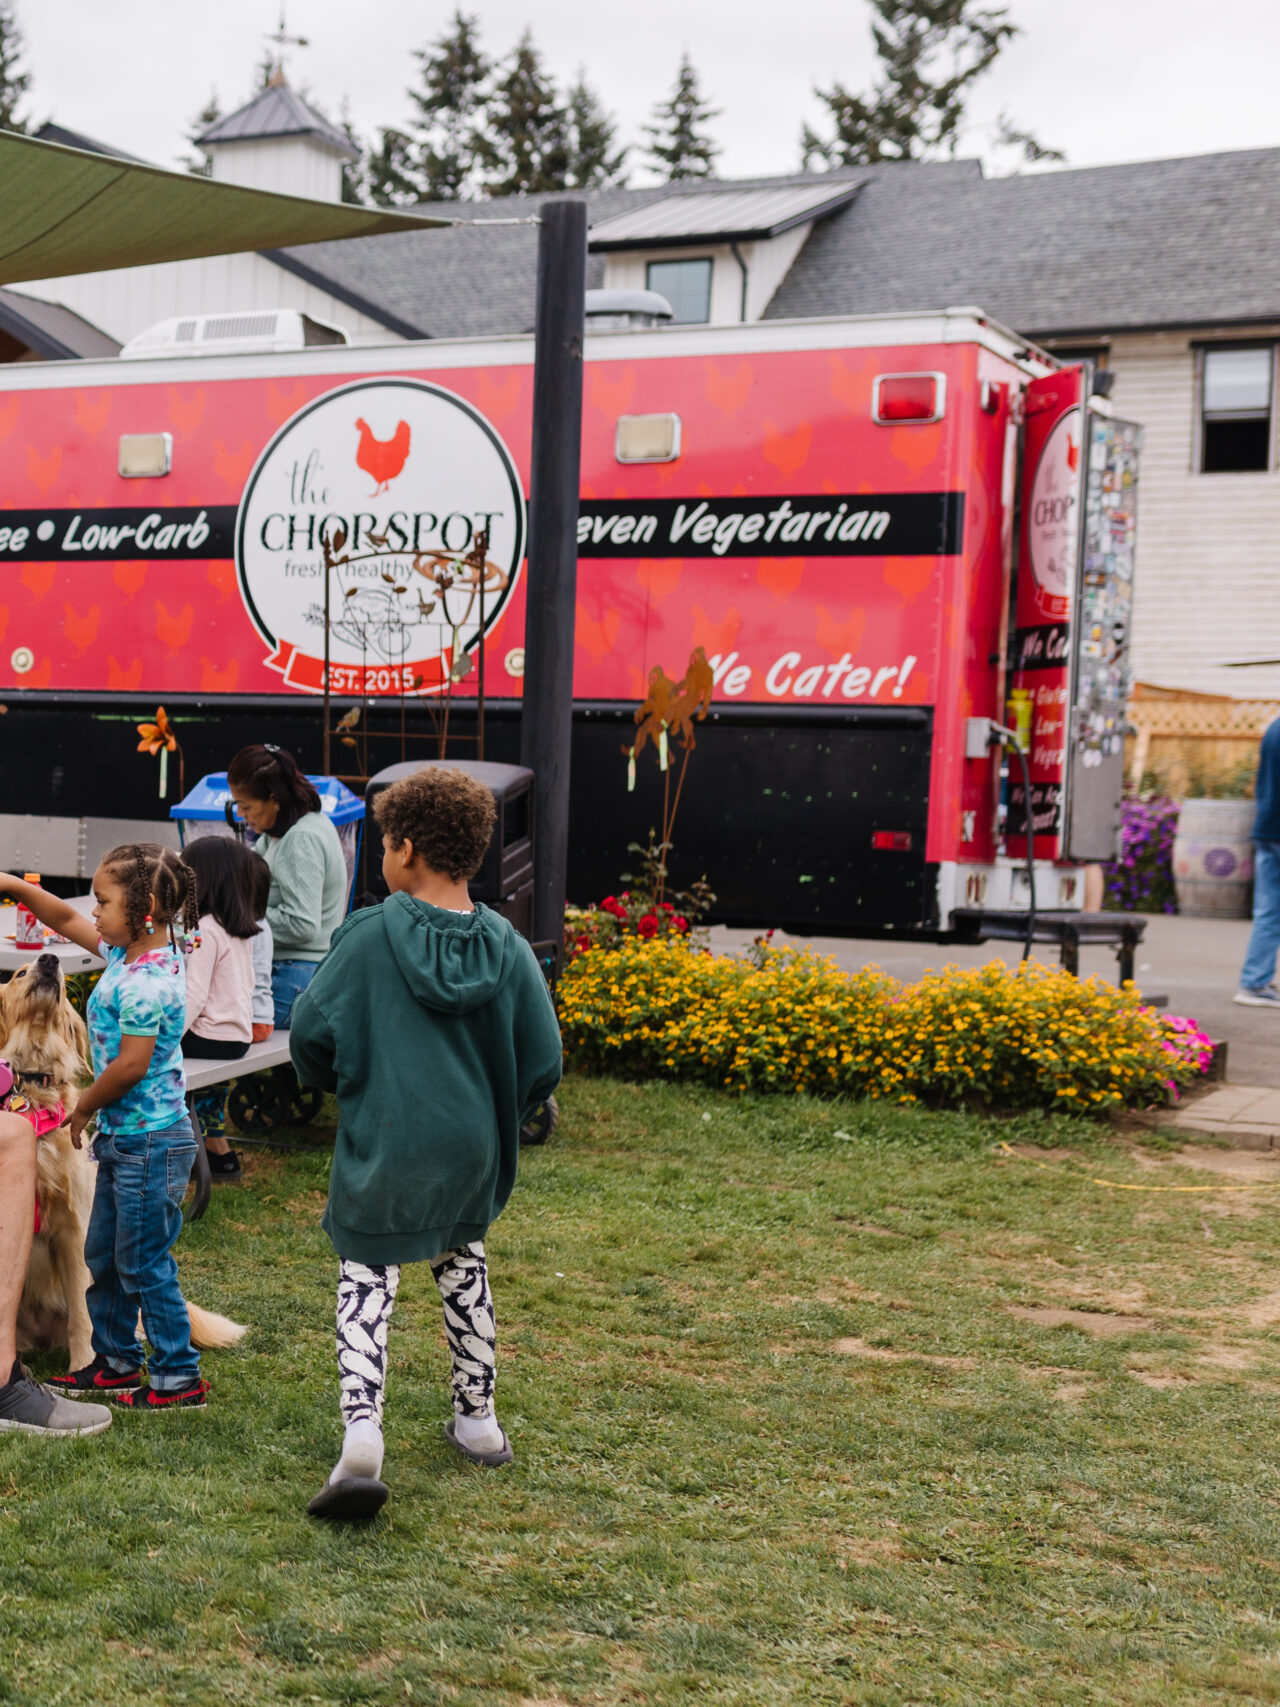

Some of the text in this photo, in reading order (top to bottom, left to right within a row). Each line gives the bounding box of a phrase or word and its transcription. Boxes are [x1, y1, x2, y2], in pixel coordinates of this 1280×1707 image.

[62, 511, 210, 550] Low-Carb
[260, 507, 504, 552] CHOP SPOT
[669, 501, 890, 555] Vegetarian
[346, 559, 413, 583] healthy
[365, 667, 415, 691] 2015
[765, 652, 917, 698] Cater!
